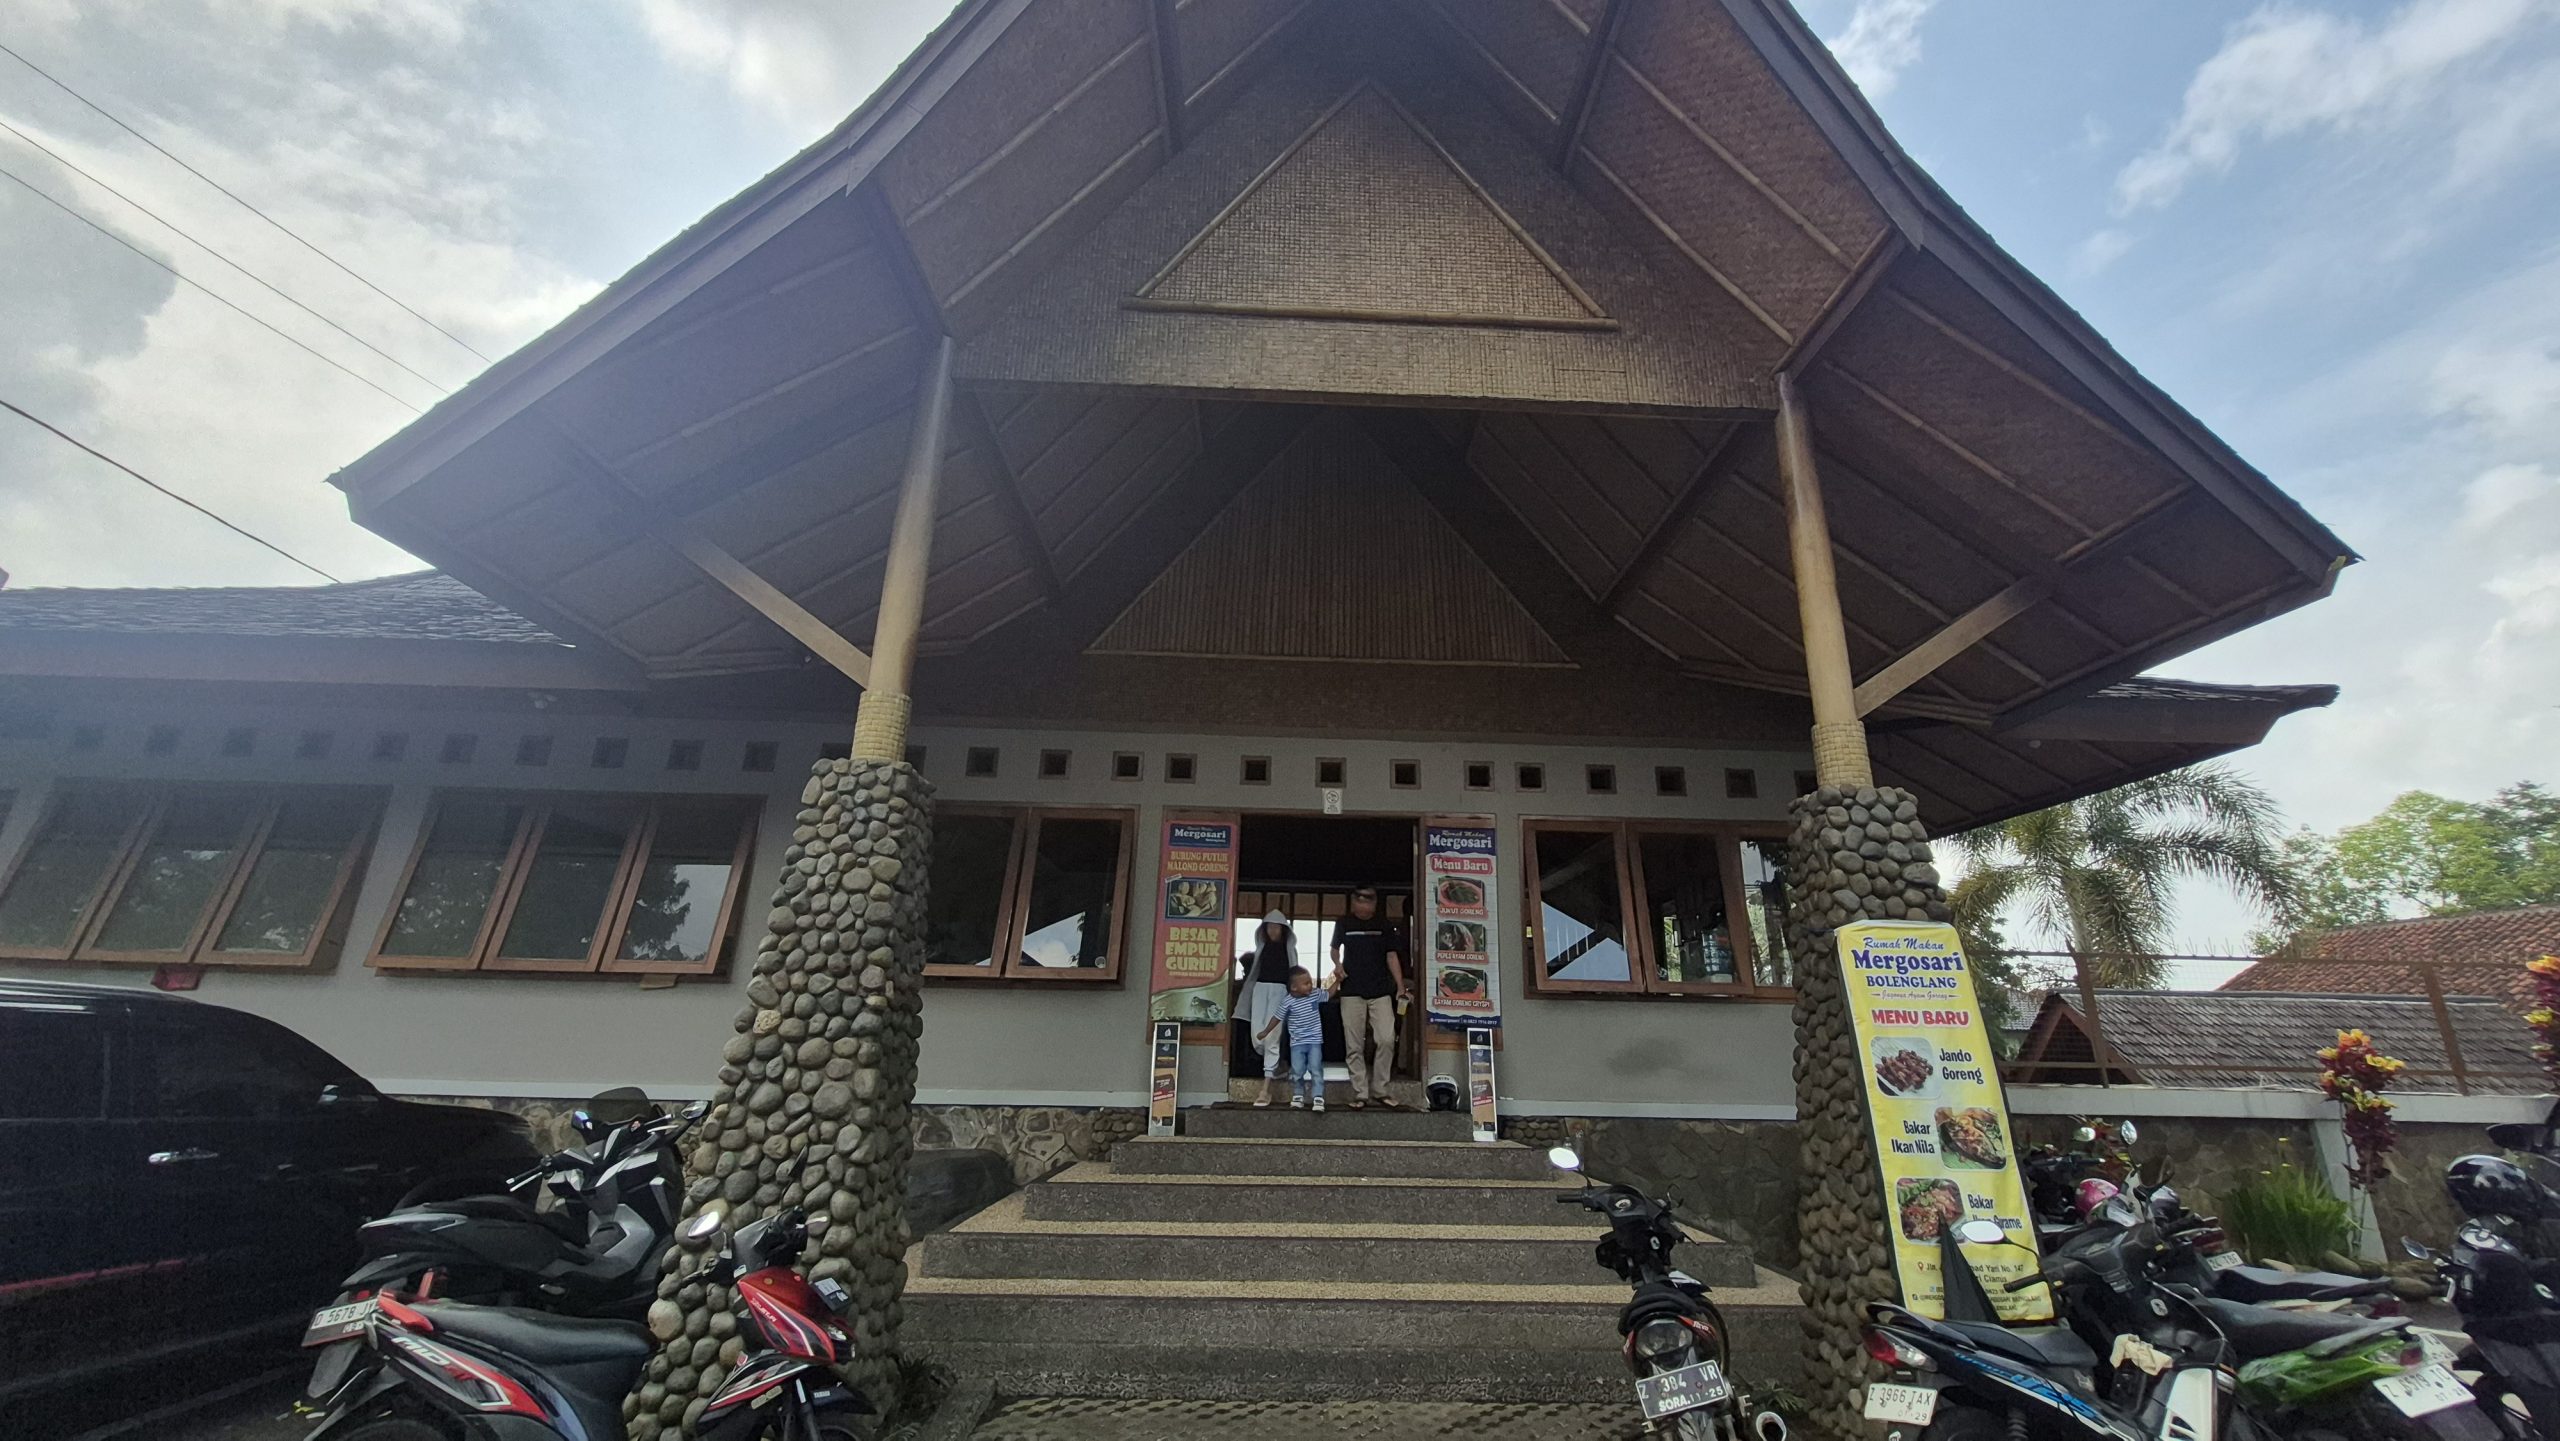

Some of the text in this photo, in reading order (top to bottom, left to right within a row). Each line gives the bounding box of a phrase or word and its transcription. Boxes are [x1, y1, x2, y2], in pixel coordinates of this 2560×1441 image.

[1174, 828, 1226, 839] Mergosari
[1429, 834, 1492, 849] Mergosari
[1199, 863, 1229, 873] GORENG
[1433, 858, 1488, 871] Menu Baru
[1169, 927, 1218, 942] BESAR
[1165, 941, 1221, 957] EMPUK
[1863, 936, 1944, 950] Rumah Makan
[1165, 956, 1218, 971] GURIH
[1851, 949, 1965, 975] Mergosari
[1866, 975, 1957, 988] BOLENGLANG
[1871, 1009, 1969, 1026] MENU BARU
[1939, 1048, 1972, 1062] Jando
[1942, 1066, 1984, 1084] Goreng
[1903, 1120, 1931, 1135] Bakar
[1891, 1138, 1935, 1154] Ikan Nila
[1967, 1193, 1994, 1209] Bakar
[327, 1306, 357, 1323] 5678
[1639, 1383, 1649, 1399] Z
[1699, 1365, 1718, 1381] VR
[1869, 1387, 1933, 1406] Z 3966 TAX
[2382, 1384, 2399, 1398] Z
